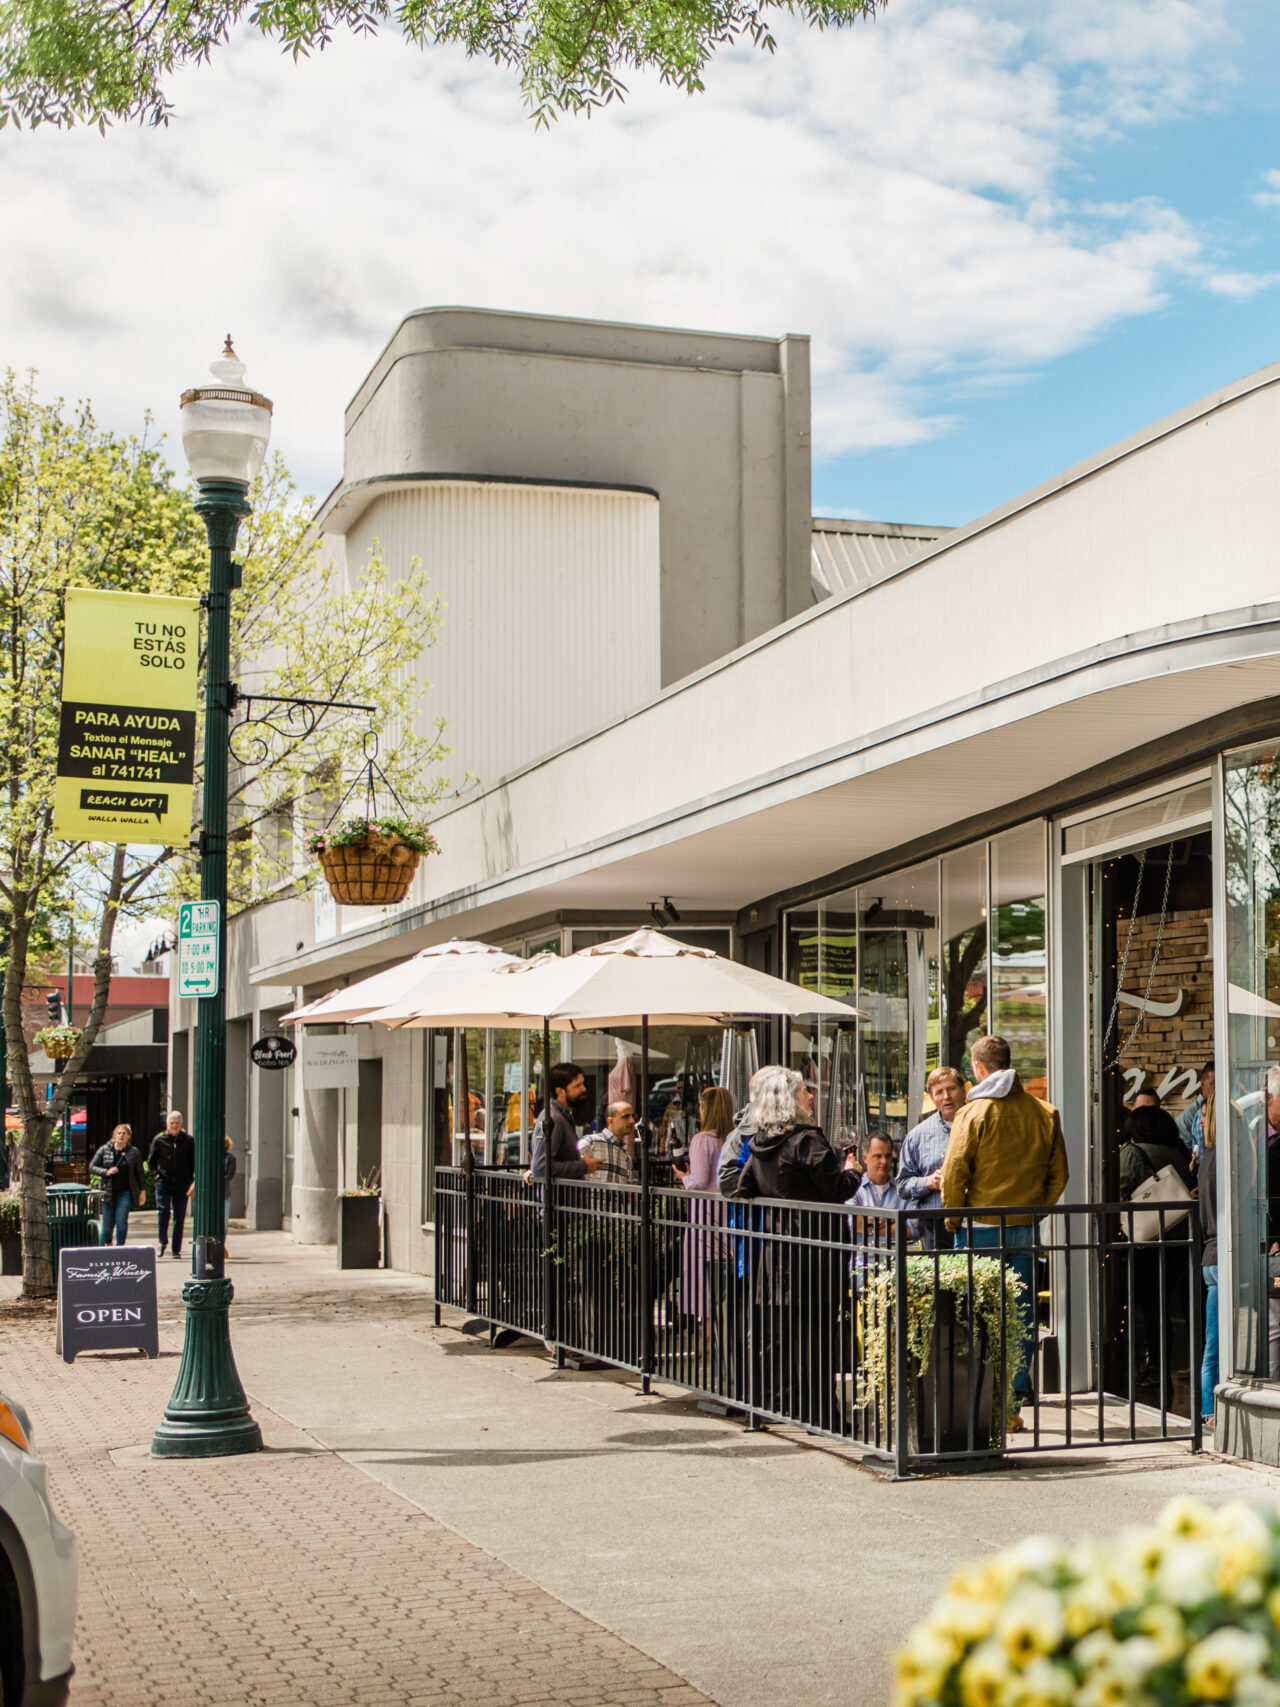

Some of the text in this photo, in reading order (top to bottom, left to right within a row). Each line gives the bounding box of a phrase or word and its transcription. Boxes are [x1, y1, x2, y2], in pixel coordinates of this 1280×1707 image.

[135, 622, 186, 638] TU NO
[133, 637, 186, 654] ESTÁS
[140, 654, 186, 670] SOLO
[75, 710, 181, 731] PARA AYUDA
[84, 732, 172, 748] Textea el Mensaje
[70, 744, 126, 760] SANAR
[92, 764, 160, 780] al 741741
[87, 795, 126, 806] REACH
[182, 907, 210, 934] 2 HR
[192, 920, 216, 934] PARKING
[202, 944, 210, 954] AM
[206, 961, 214, 973] PM
[66, 1262, 152, 1285] Family Winery
[77, 1307, 142, 1323] OPEN
